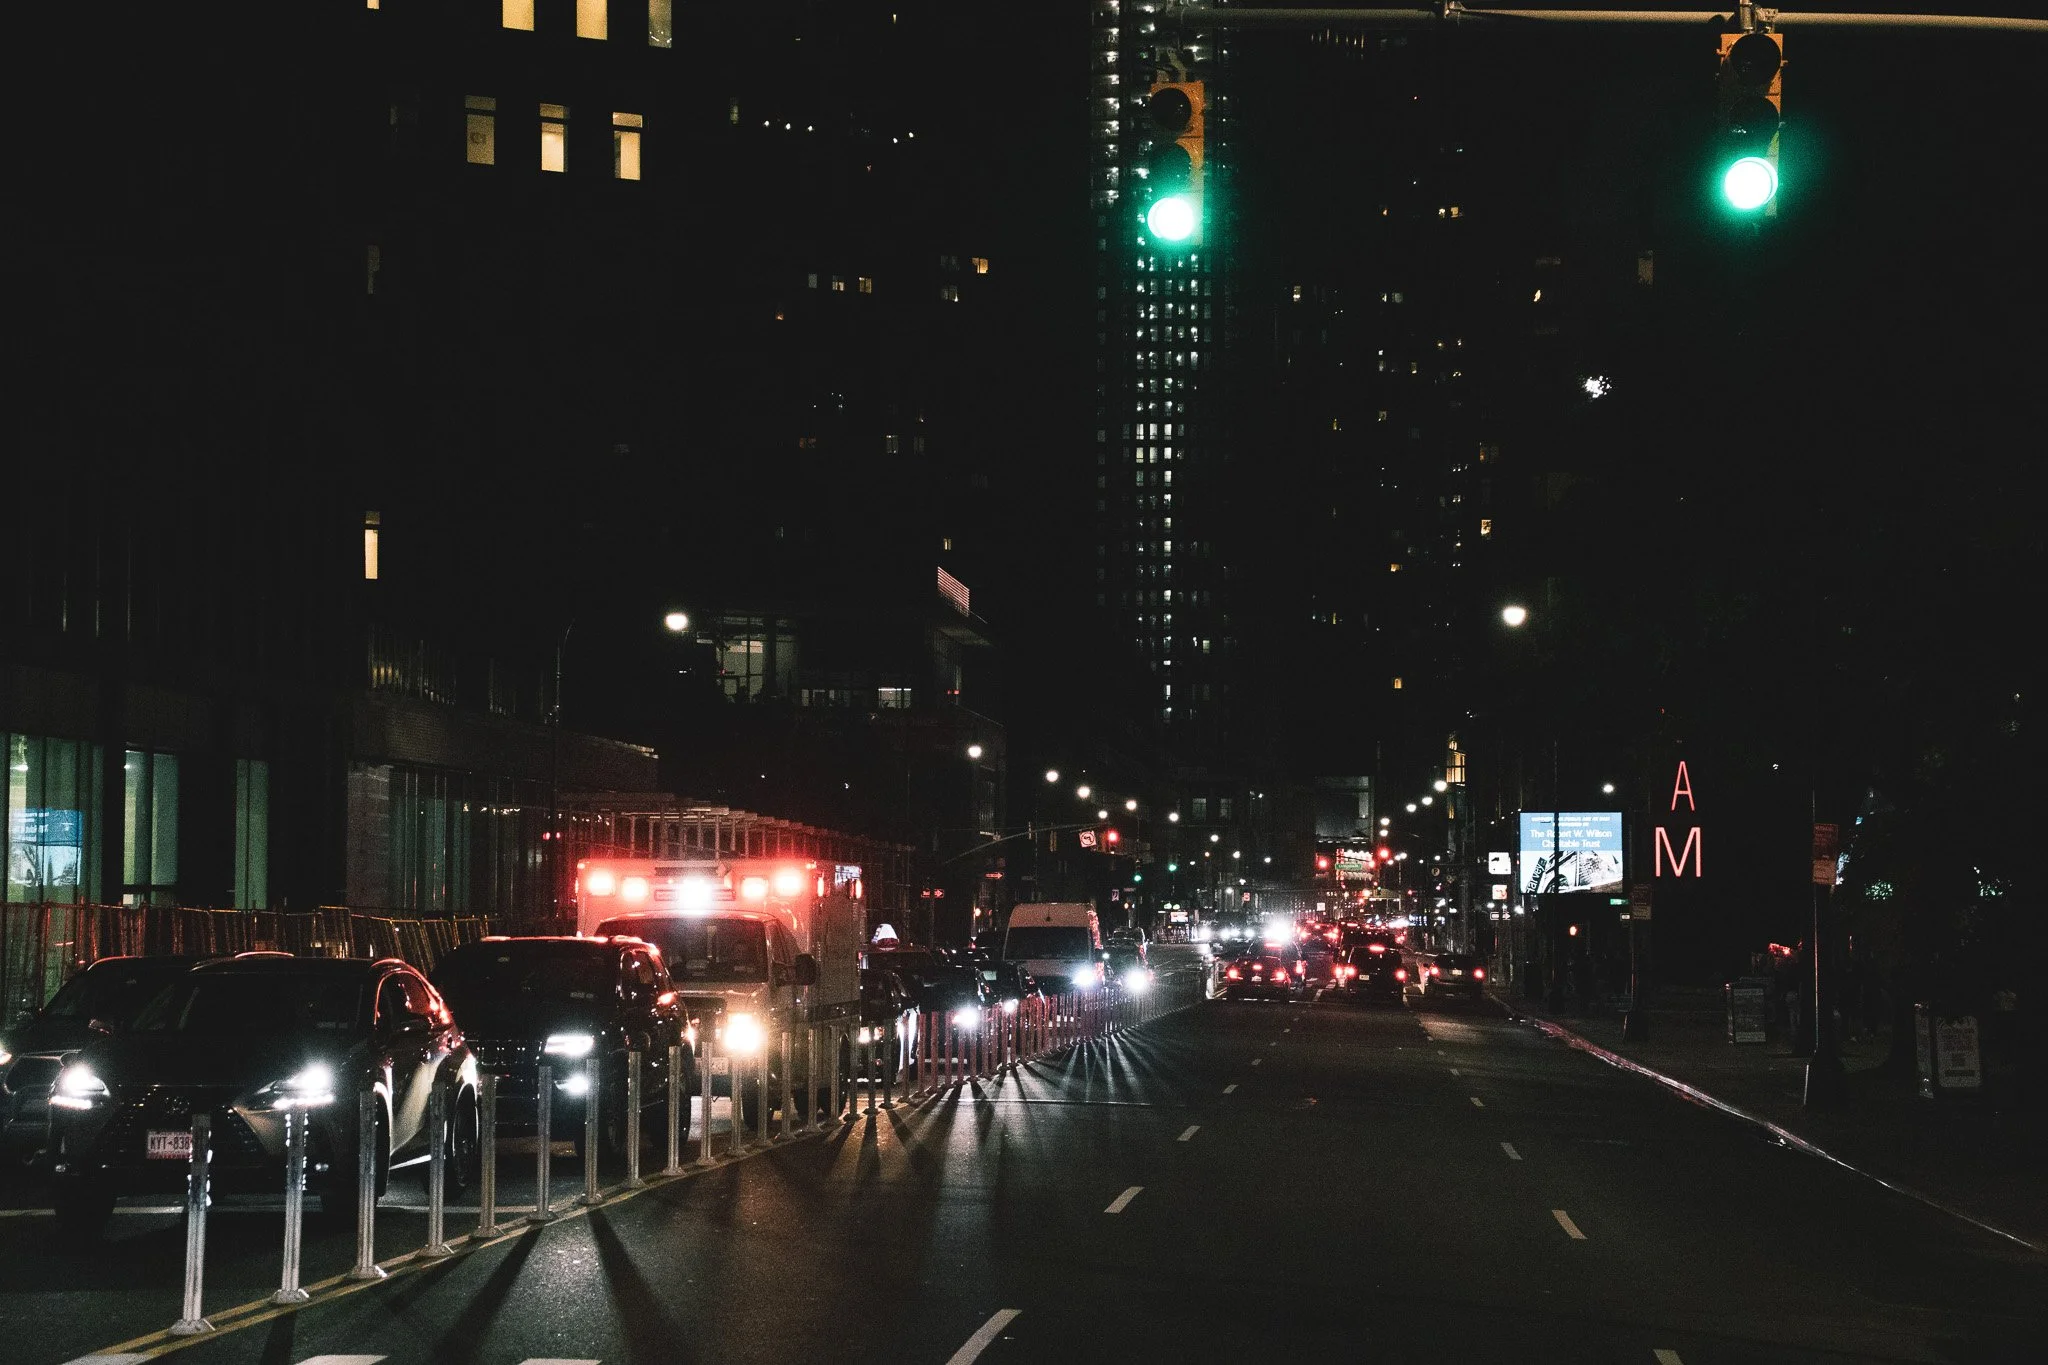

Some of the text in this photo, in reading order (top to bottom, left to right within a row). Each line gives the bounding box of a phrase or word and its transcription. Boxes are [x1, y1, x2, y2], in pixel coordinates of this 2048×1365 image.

[1530, 829, 1545, 838] The
[1574, 829, 1585, 838] W.
[1586, 829, 1613, 838] Wilson
[1541, 839, 1601, 848] Chaitable Trust
